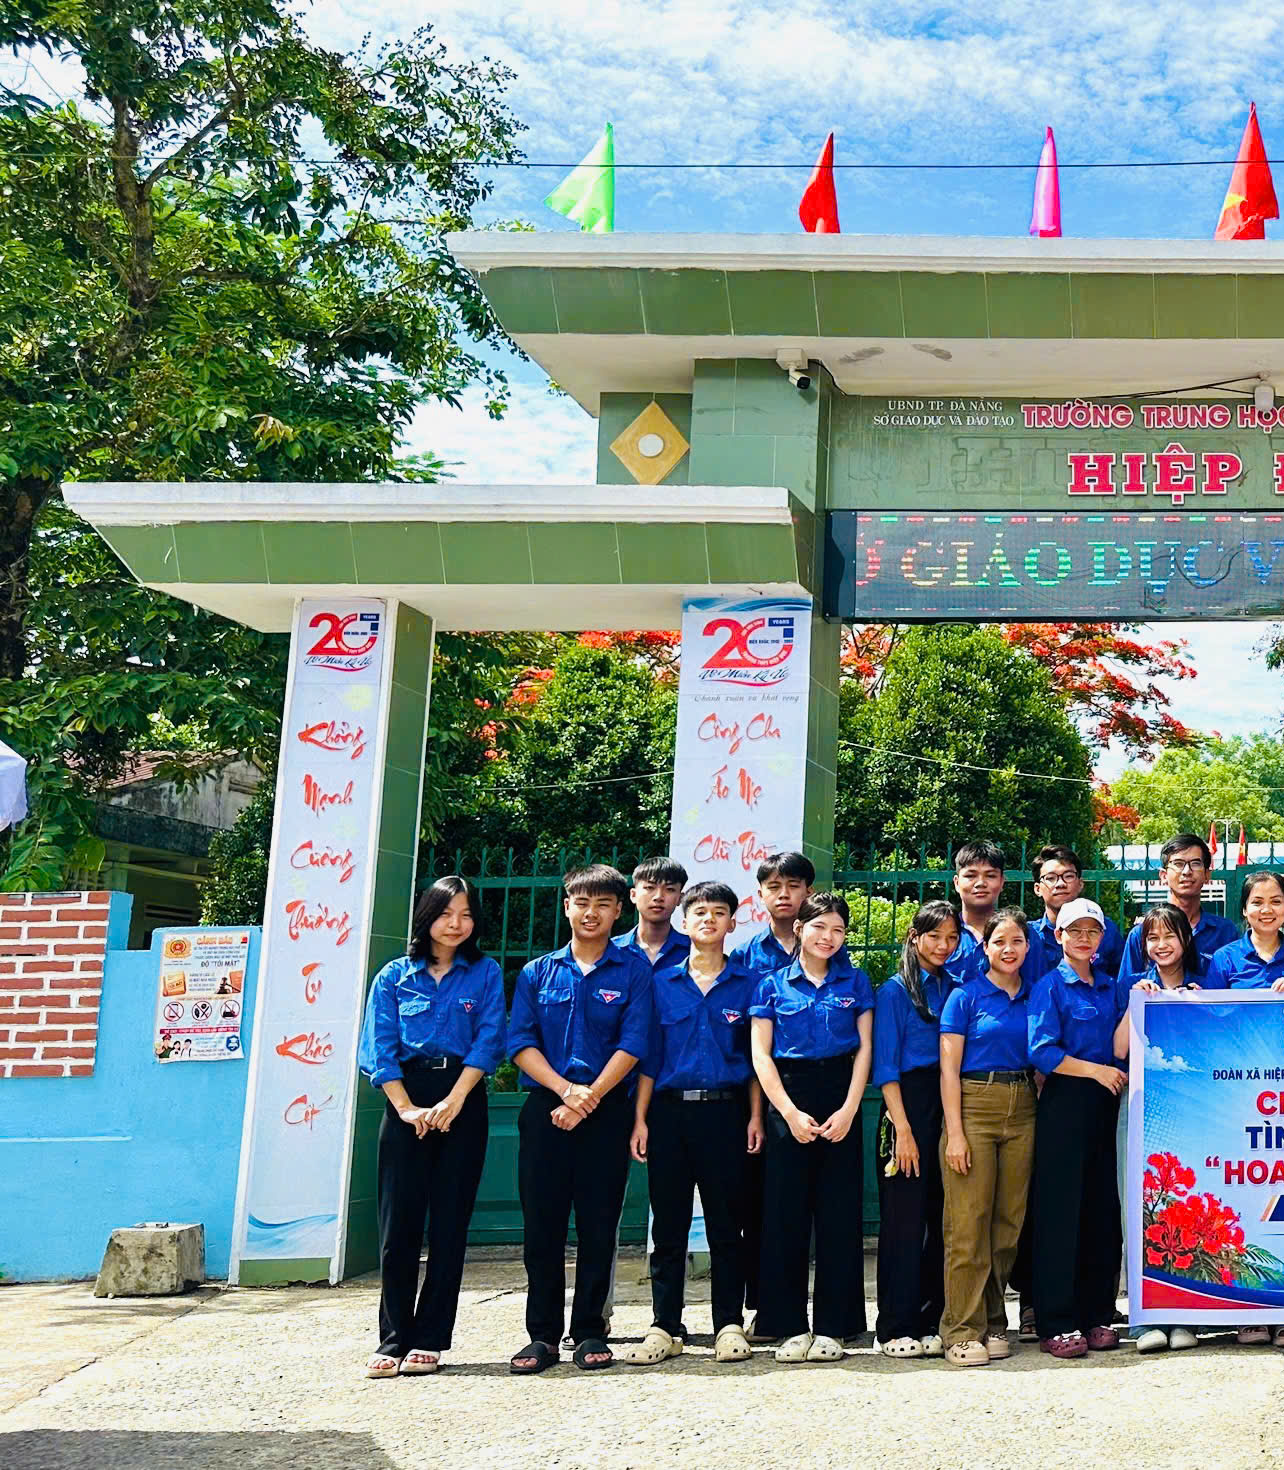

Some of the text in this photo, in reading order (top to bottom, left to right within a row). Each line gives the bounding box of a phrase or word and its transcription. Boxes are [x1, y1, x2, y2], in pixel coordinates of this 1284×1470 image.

[873, 412, 1014, 428] SỞ GIÁO DỤC VÀ ĐÀO TẠO
[888, 400, 924, 411] UBND
[950, 398, 966, 411] ĐÀ
[1021, 399, 1134, 429] TRƯỜNG
[1141, 405, 1230, 429] TRUNG
[1068, 442, 1243, 506] HIỆP
[900, 532, 1073, 586] GIÁO
[1088, 540, 1225, 594] DỤC
[306, 612, 378, 656] 20
[702, 617, 793, 669] 20
[746, 712, 781, 741] Cha
[303, 774, 353, 819] Mạnh
[1212, 1067, 1243, 1080] ĐOÀN
[1246, 1067, 1261, 1080] XÃ
